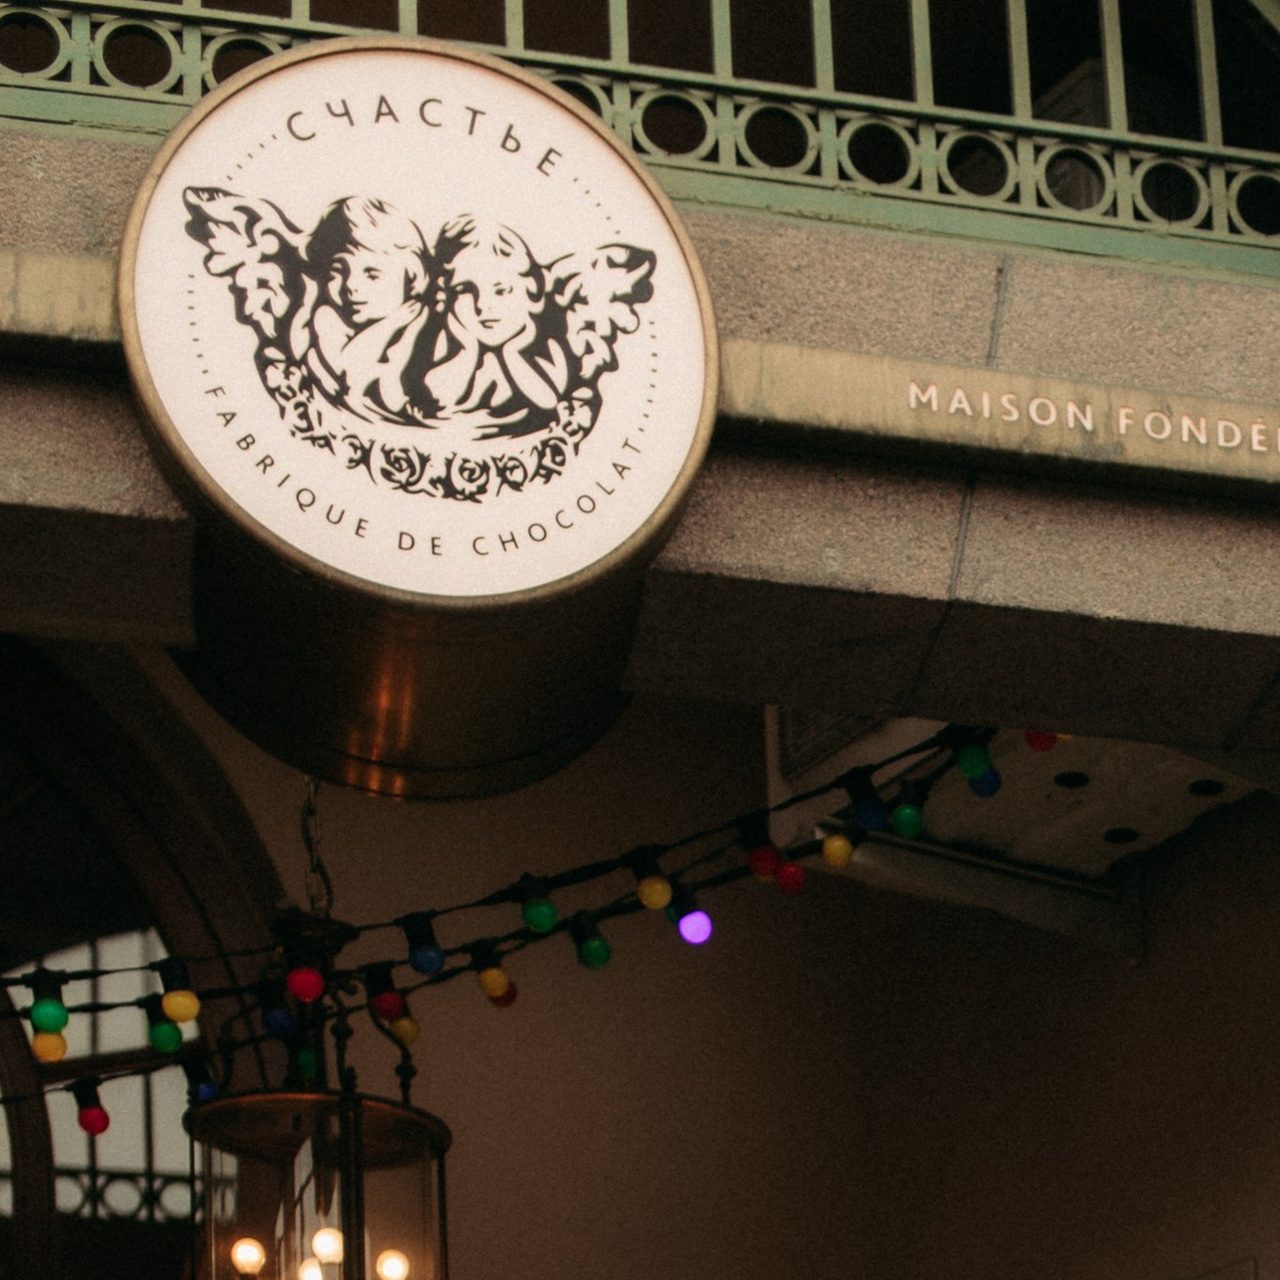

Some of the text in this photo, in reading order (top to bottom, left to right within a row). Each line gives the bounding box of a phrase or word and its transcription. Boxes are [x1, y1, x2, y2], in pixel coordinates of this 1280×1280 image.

[286, 94, 562, 177] СЧАСТЬЕ
[908, 382, 1095, 432] MAISON
[205, 385, 640, 556] FABRIQUE DE CHOCOLAT
